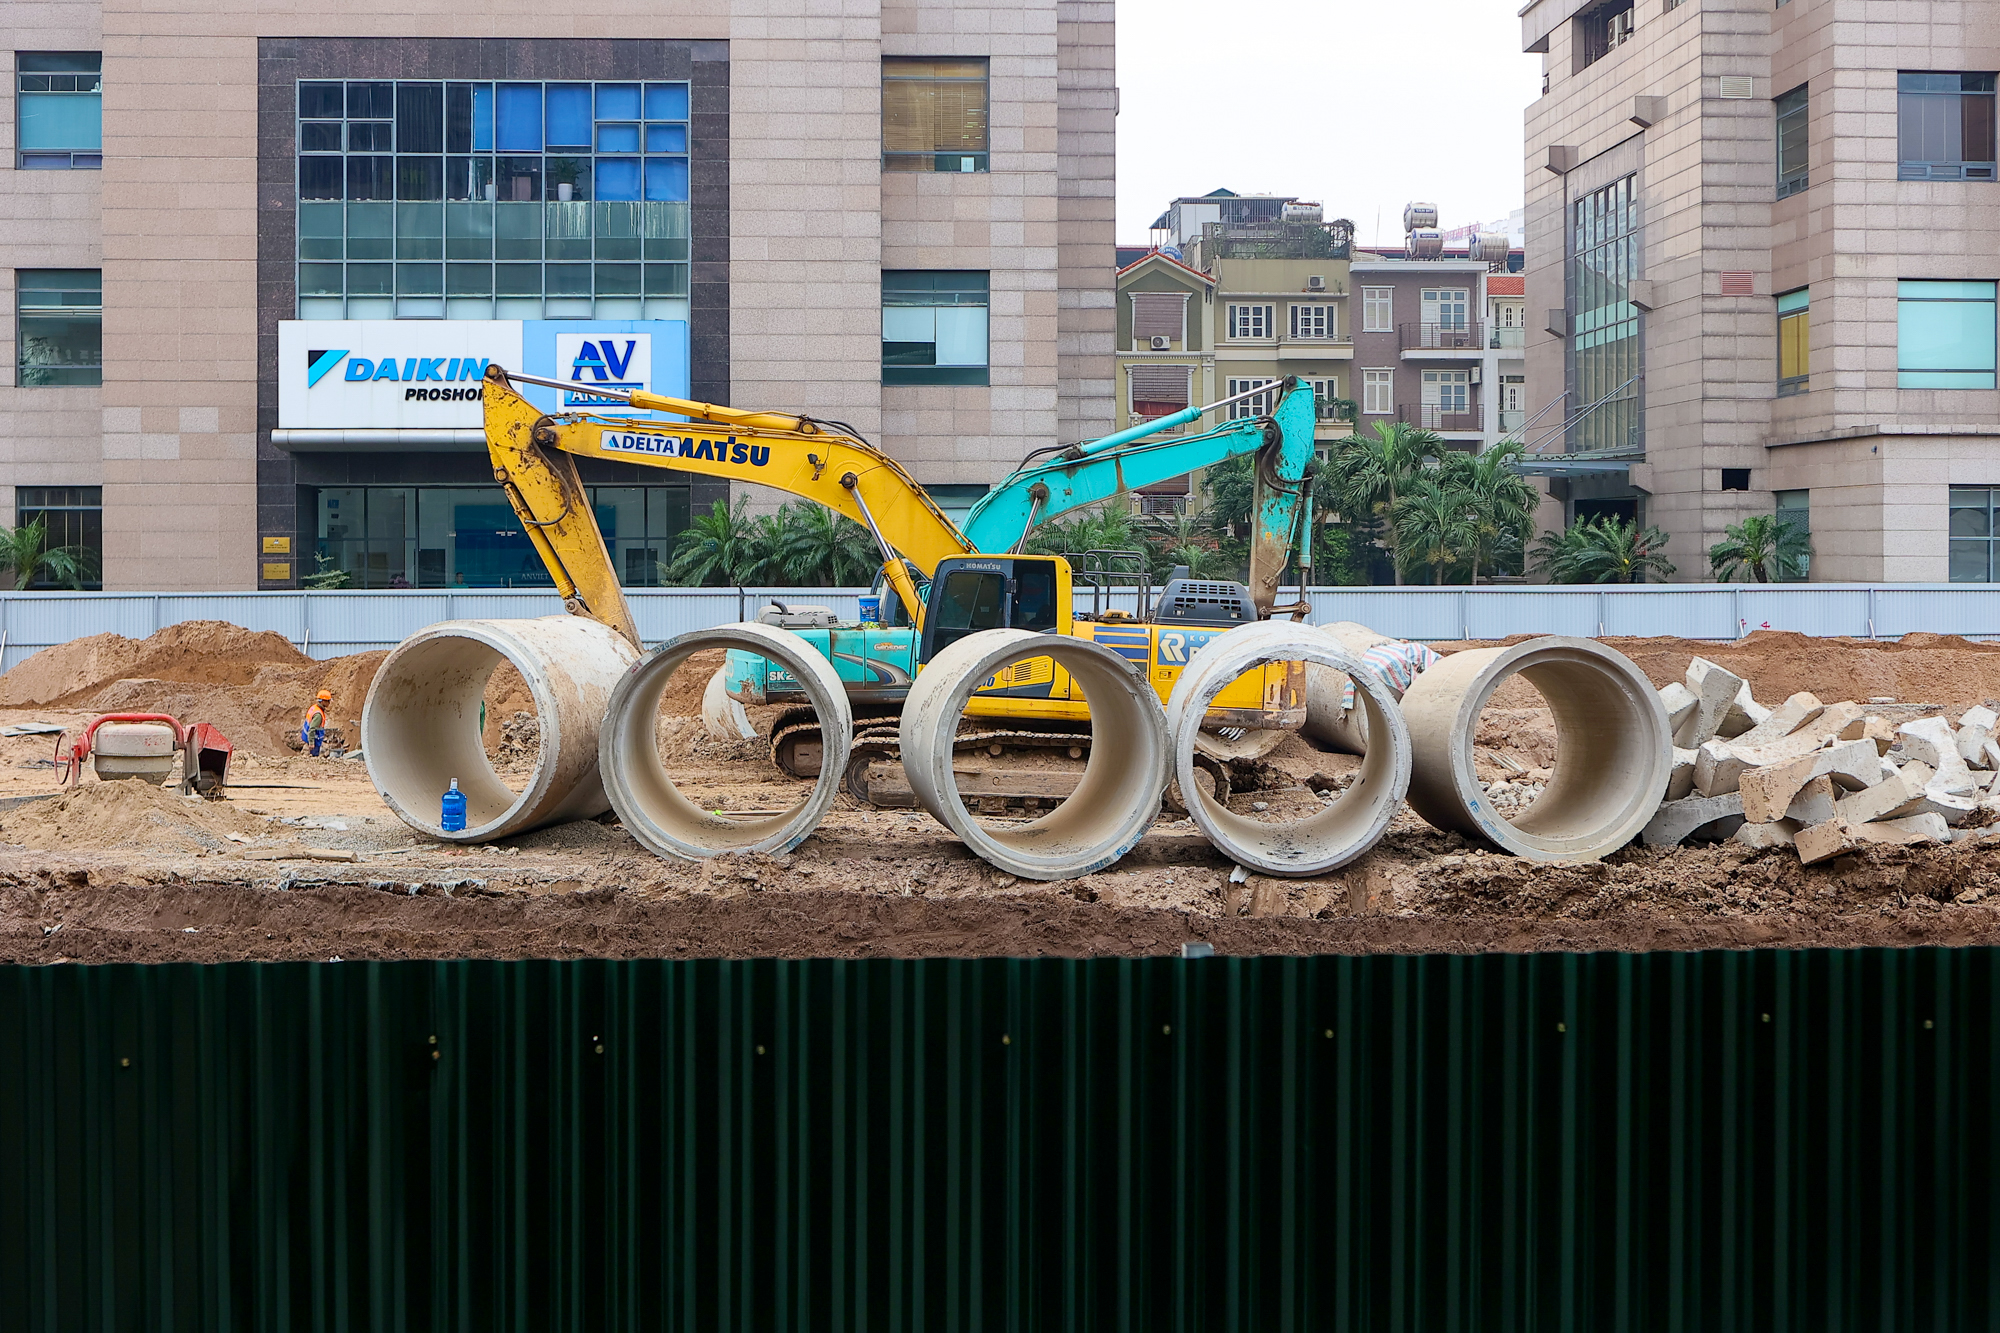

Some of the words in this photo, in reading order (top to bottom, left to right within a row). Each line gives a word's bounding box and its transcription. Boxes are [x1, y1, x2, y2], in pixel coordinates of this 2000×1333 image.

[344, 357, 490, 381] DAIKIN
[571, 340, 636, 380] AV
[621, 434, 675, 454] DELTA
[966, 562, 1001, 570] KOMATSU
